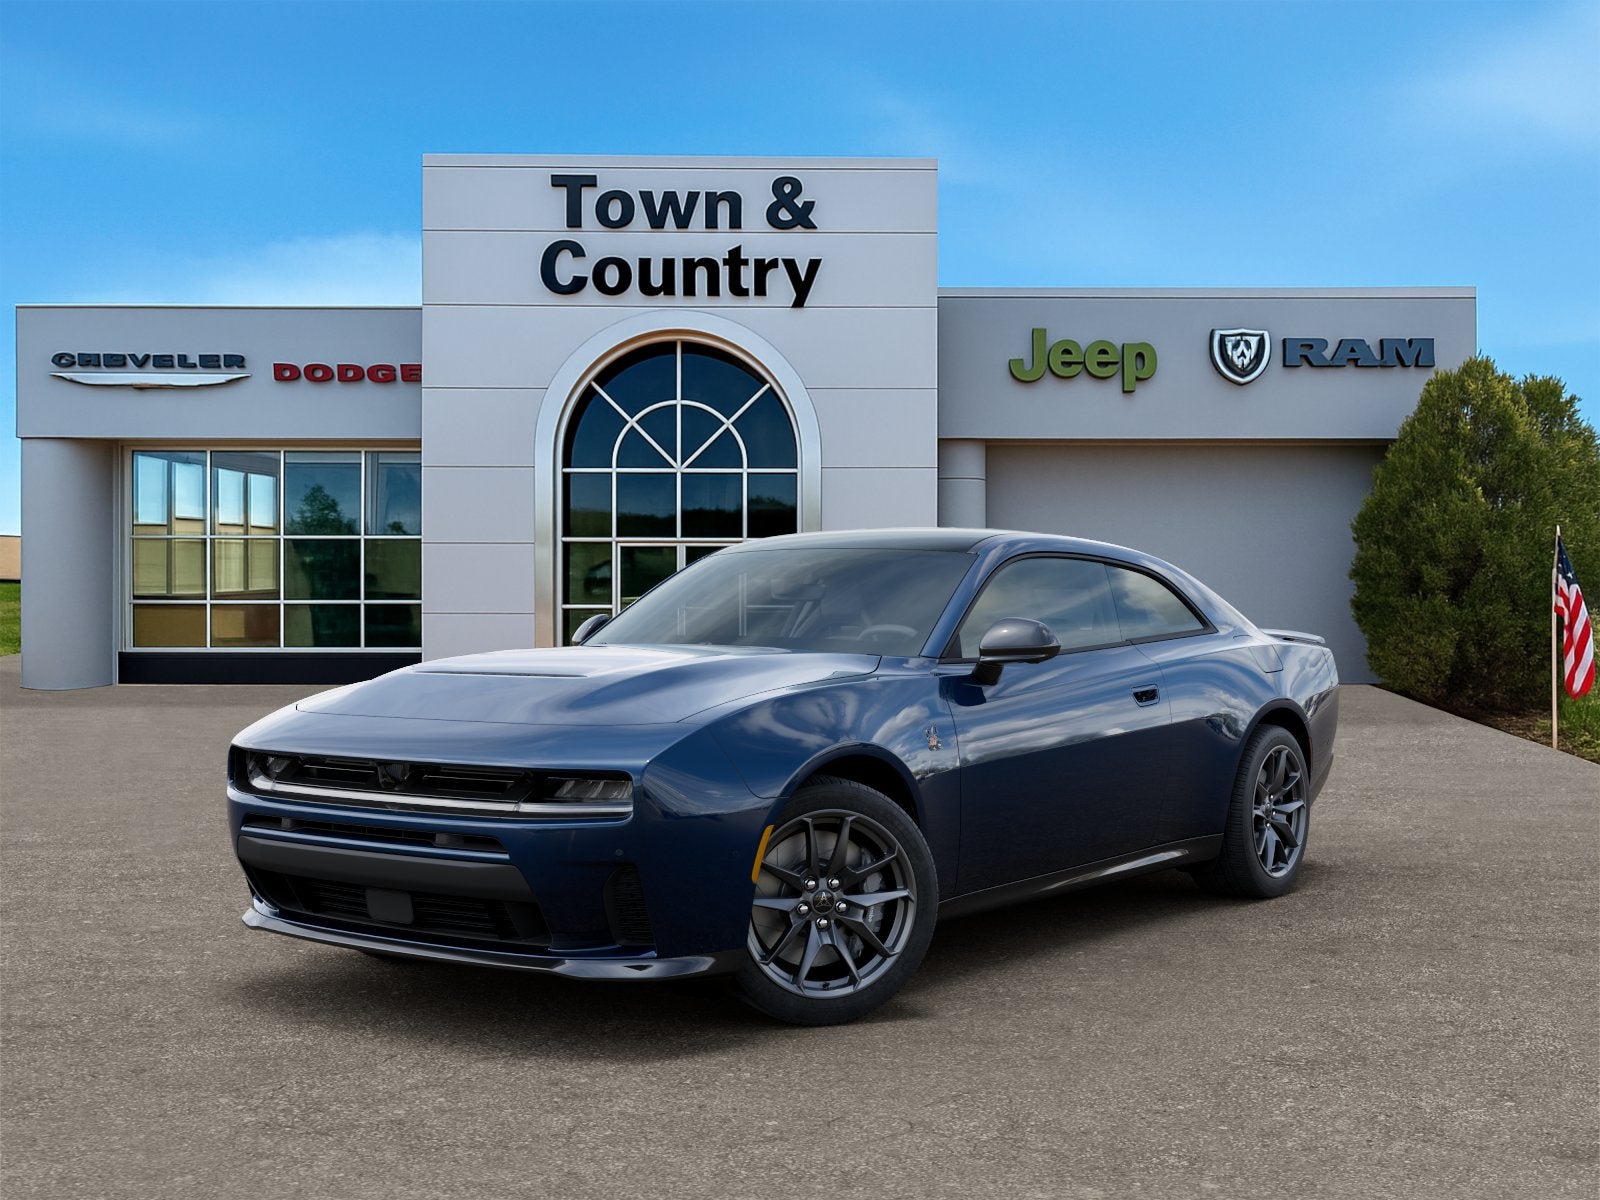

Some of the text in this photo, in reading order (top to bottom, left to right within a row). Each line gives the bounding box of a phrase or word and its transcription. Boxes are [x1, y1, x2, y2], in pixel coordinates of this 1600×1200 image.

[551, 174, 818, 230] Town &
[540, 240, 822, 308] Country
[273, 363, 422, 383] DODGE
[1009, 328, 1157, 392] Jeep
[1282, 337, 1435, 368] RAM
